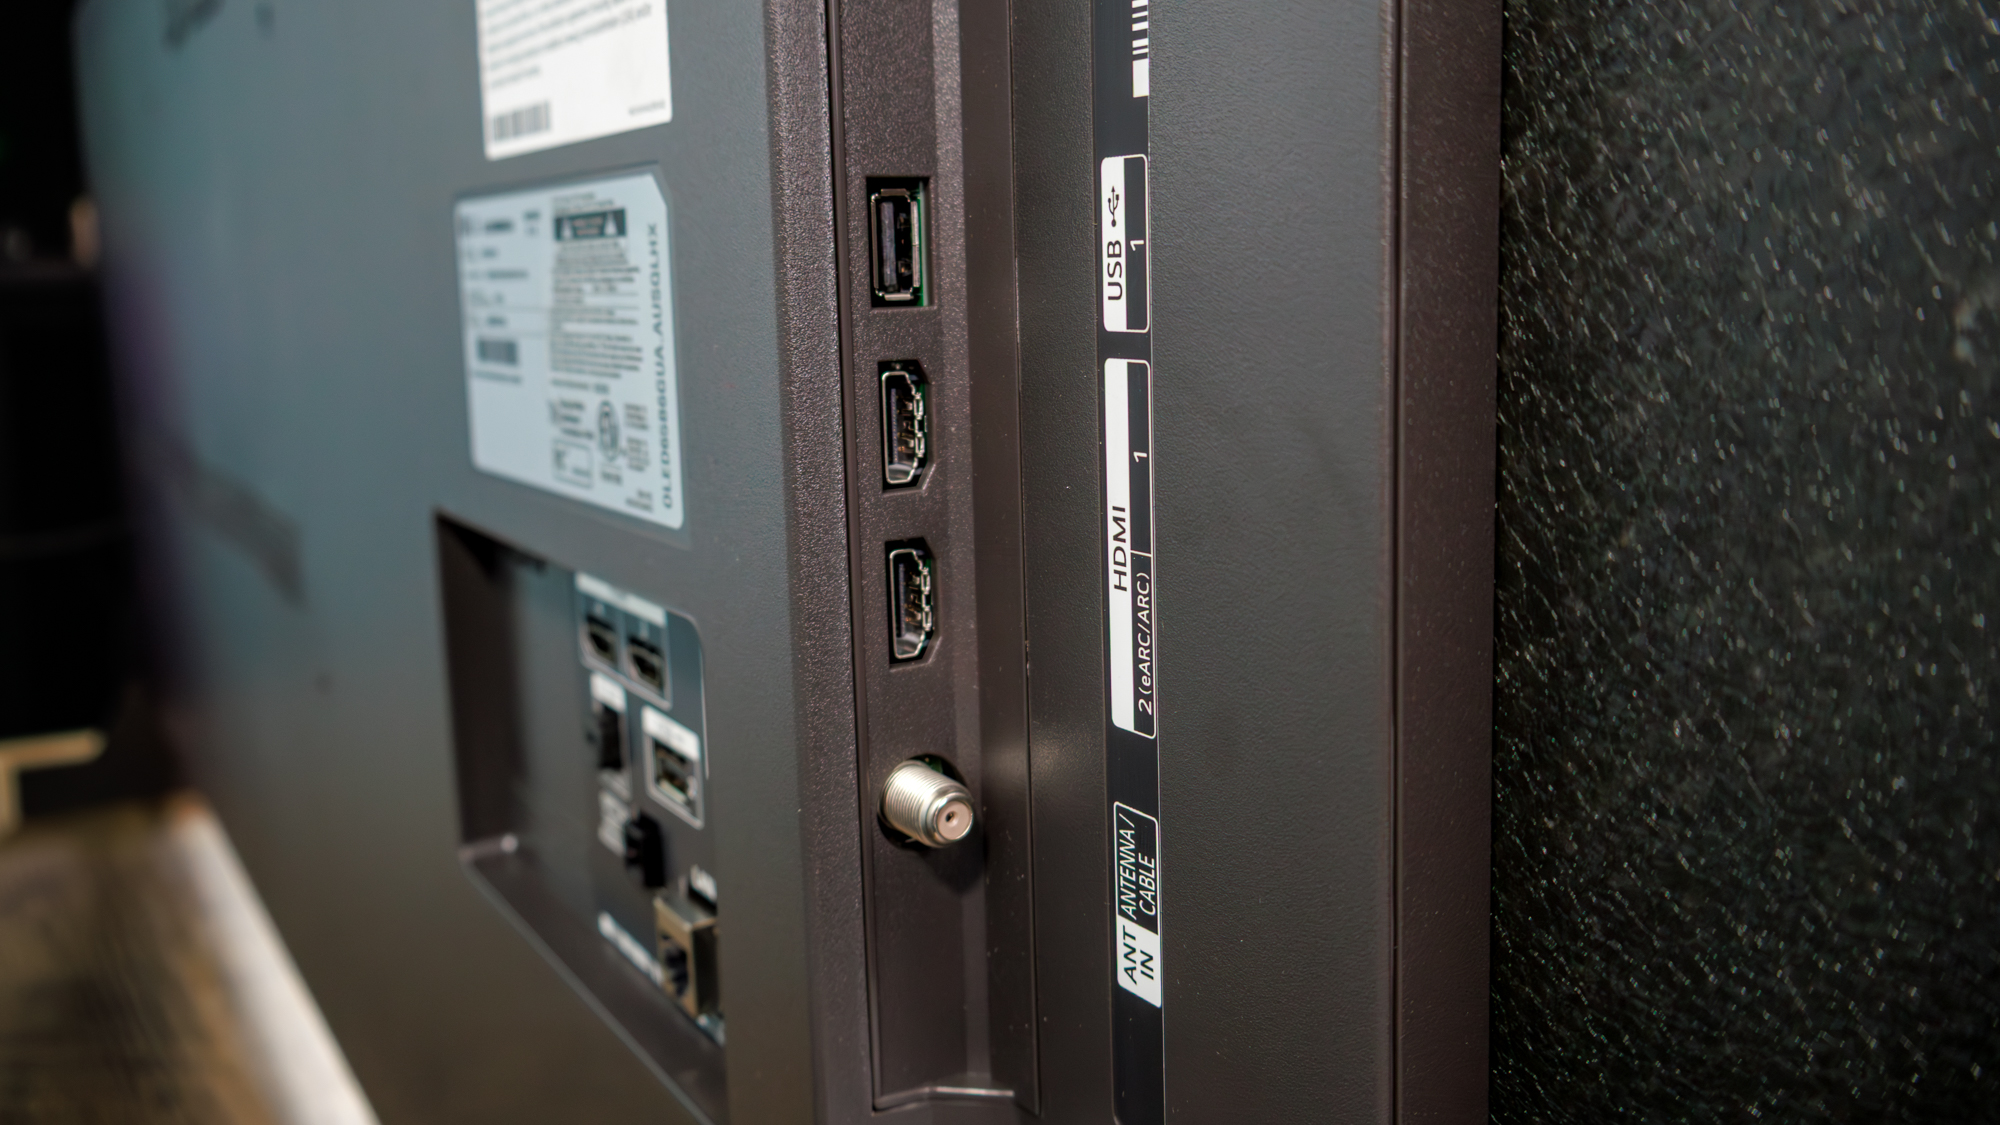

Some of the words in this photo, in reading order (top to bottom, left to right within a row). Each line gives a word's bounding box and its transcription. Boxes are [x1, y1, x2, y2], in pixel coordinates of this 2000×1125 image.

[1107, 240, 1123, 301] USB
[1130, 239, 1145, 252] 1
[1133, 450, 1148, 463] 1
[1112, 505, 1127, 593] HDMI
[1119, 813, 1137, 920] ANTENNA/
[1139, 852, 1156, 916] CABLE
[1122, 924, 1137, 985] ANT
[1140, 949, 1154, 981] IN
